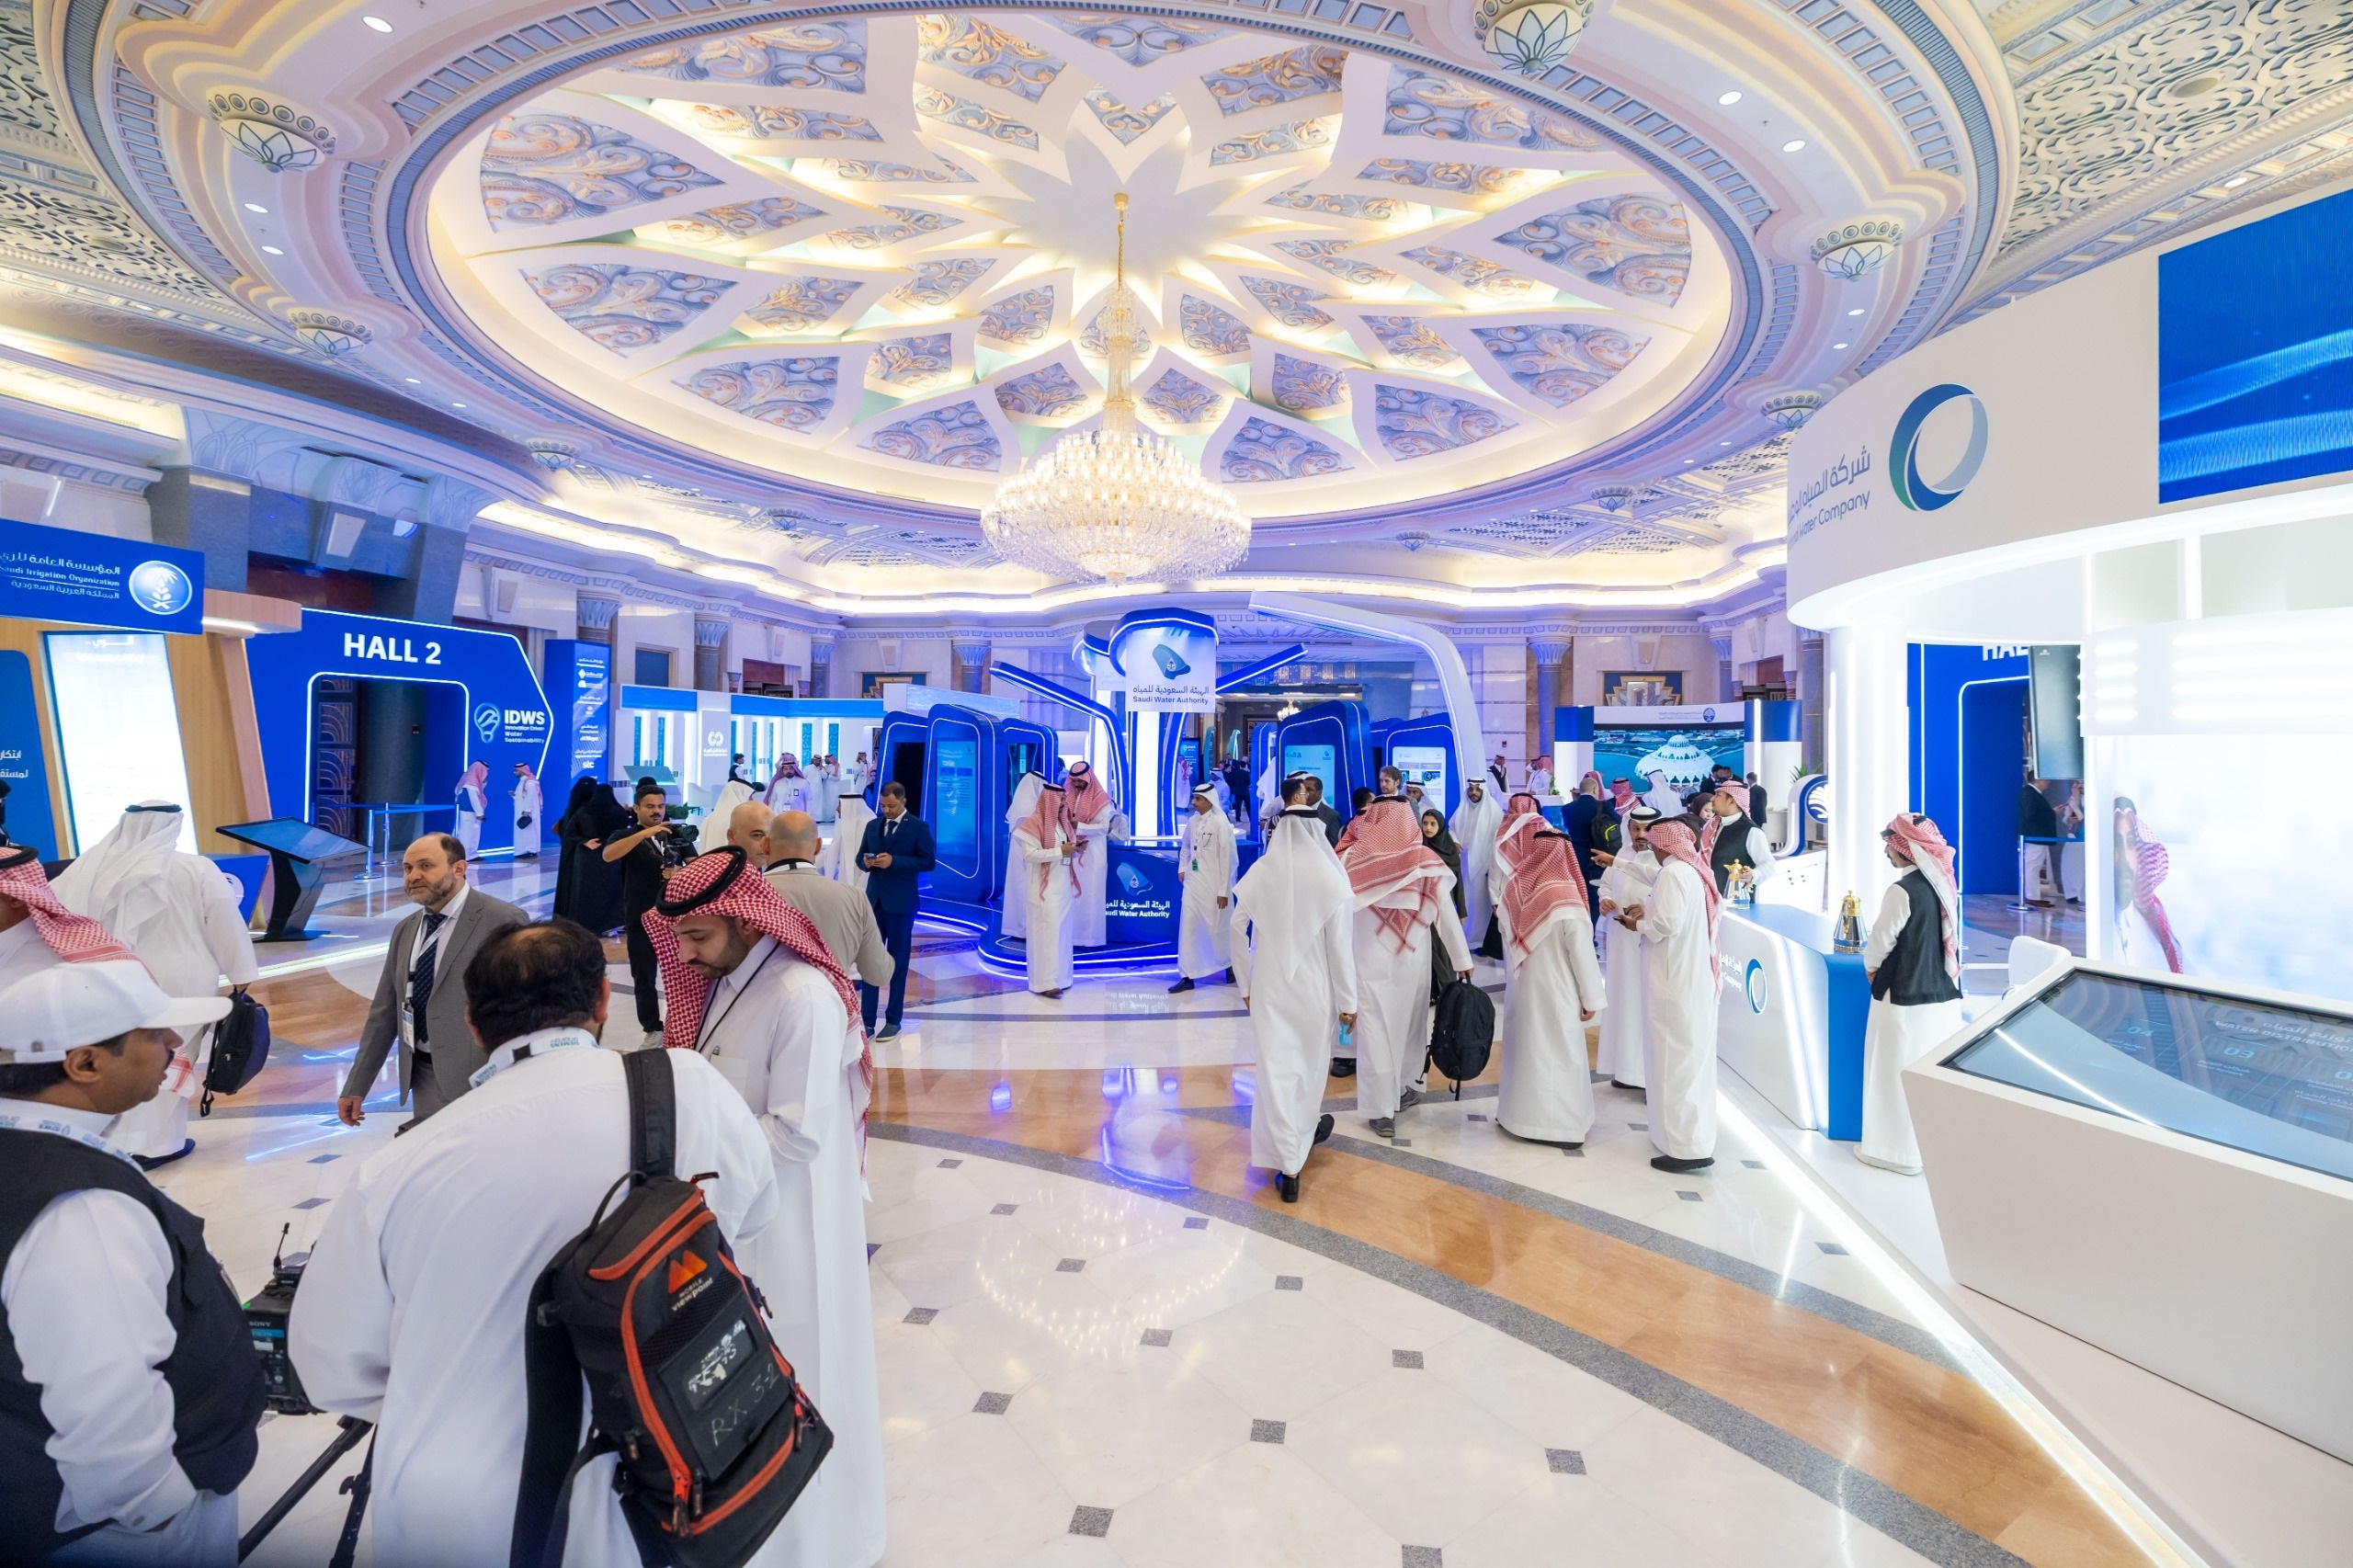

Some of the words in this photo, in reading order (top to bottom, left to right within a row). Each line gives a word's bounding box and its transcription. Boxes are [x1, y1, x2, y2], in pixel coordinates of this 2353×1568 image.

[1829, 445, 1870, 488] شركة
[1802, 469, 1828, 508] المياه
[1818, 490, 1870, 526] Company
[28, 553, 65, 567] العامة
[65, 558, 121, 575] المؤسسة
[26, 567, 67, 581] Irrigation
[68, 573, 120, 587] Organization
[11, 579, 55, 591] السعودية
[55, 585, 85, 597] العربية
[344, 631, 418, 663] HALL
[425, 642, 441, 665] 2
[1982, 645, 2029, 662] HAL
[1132, 684, 1154, 695] للمياه
[1154, 684, 1188, 696] السعودية
[1189, 686, 1210, 697] الهيئة
[1132, 696, 1154, 704] Saudi
[1154, 696, 1176, 704] Water
[1176, 697, 1209, 706] Authority
[504, 709, 546, 726] IDWS
[582, 760, 596, 769] stc
[0, 768, 28, 779] لمستق
[1105, 899, 1119, 908] للمي
[1120, 900, 1151, 910] السعودية
[1152, 900, 1171, 911] الهيئة
[1119, 909, 1139, 917] Water
[1139, 910, 1170, 919] Authority
[2126, 1026, 2155, 1038] 04
[2215, 1020, 2260, 1034] WATER
[2222, 1047, 2256, 1059] 03
[671, 1277, 714, 1312] viewpoint
[678, 1278, 703, 1299] MOBILE
